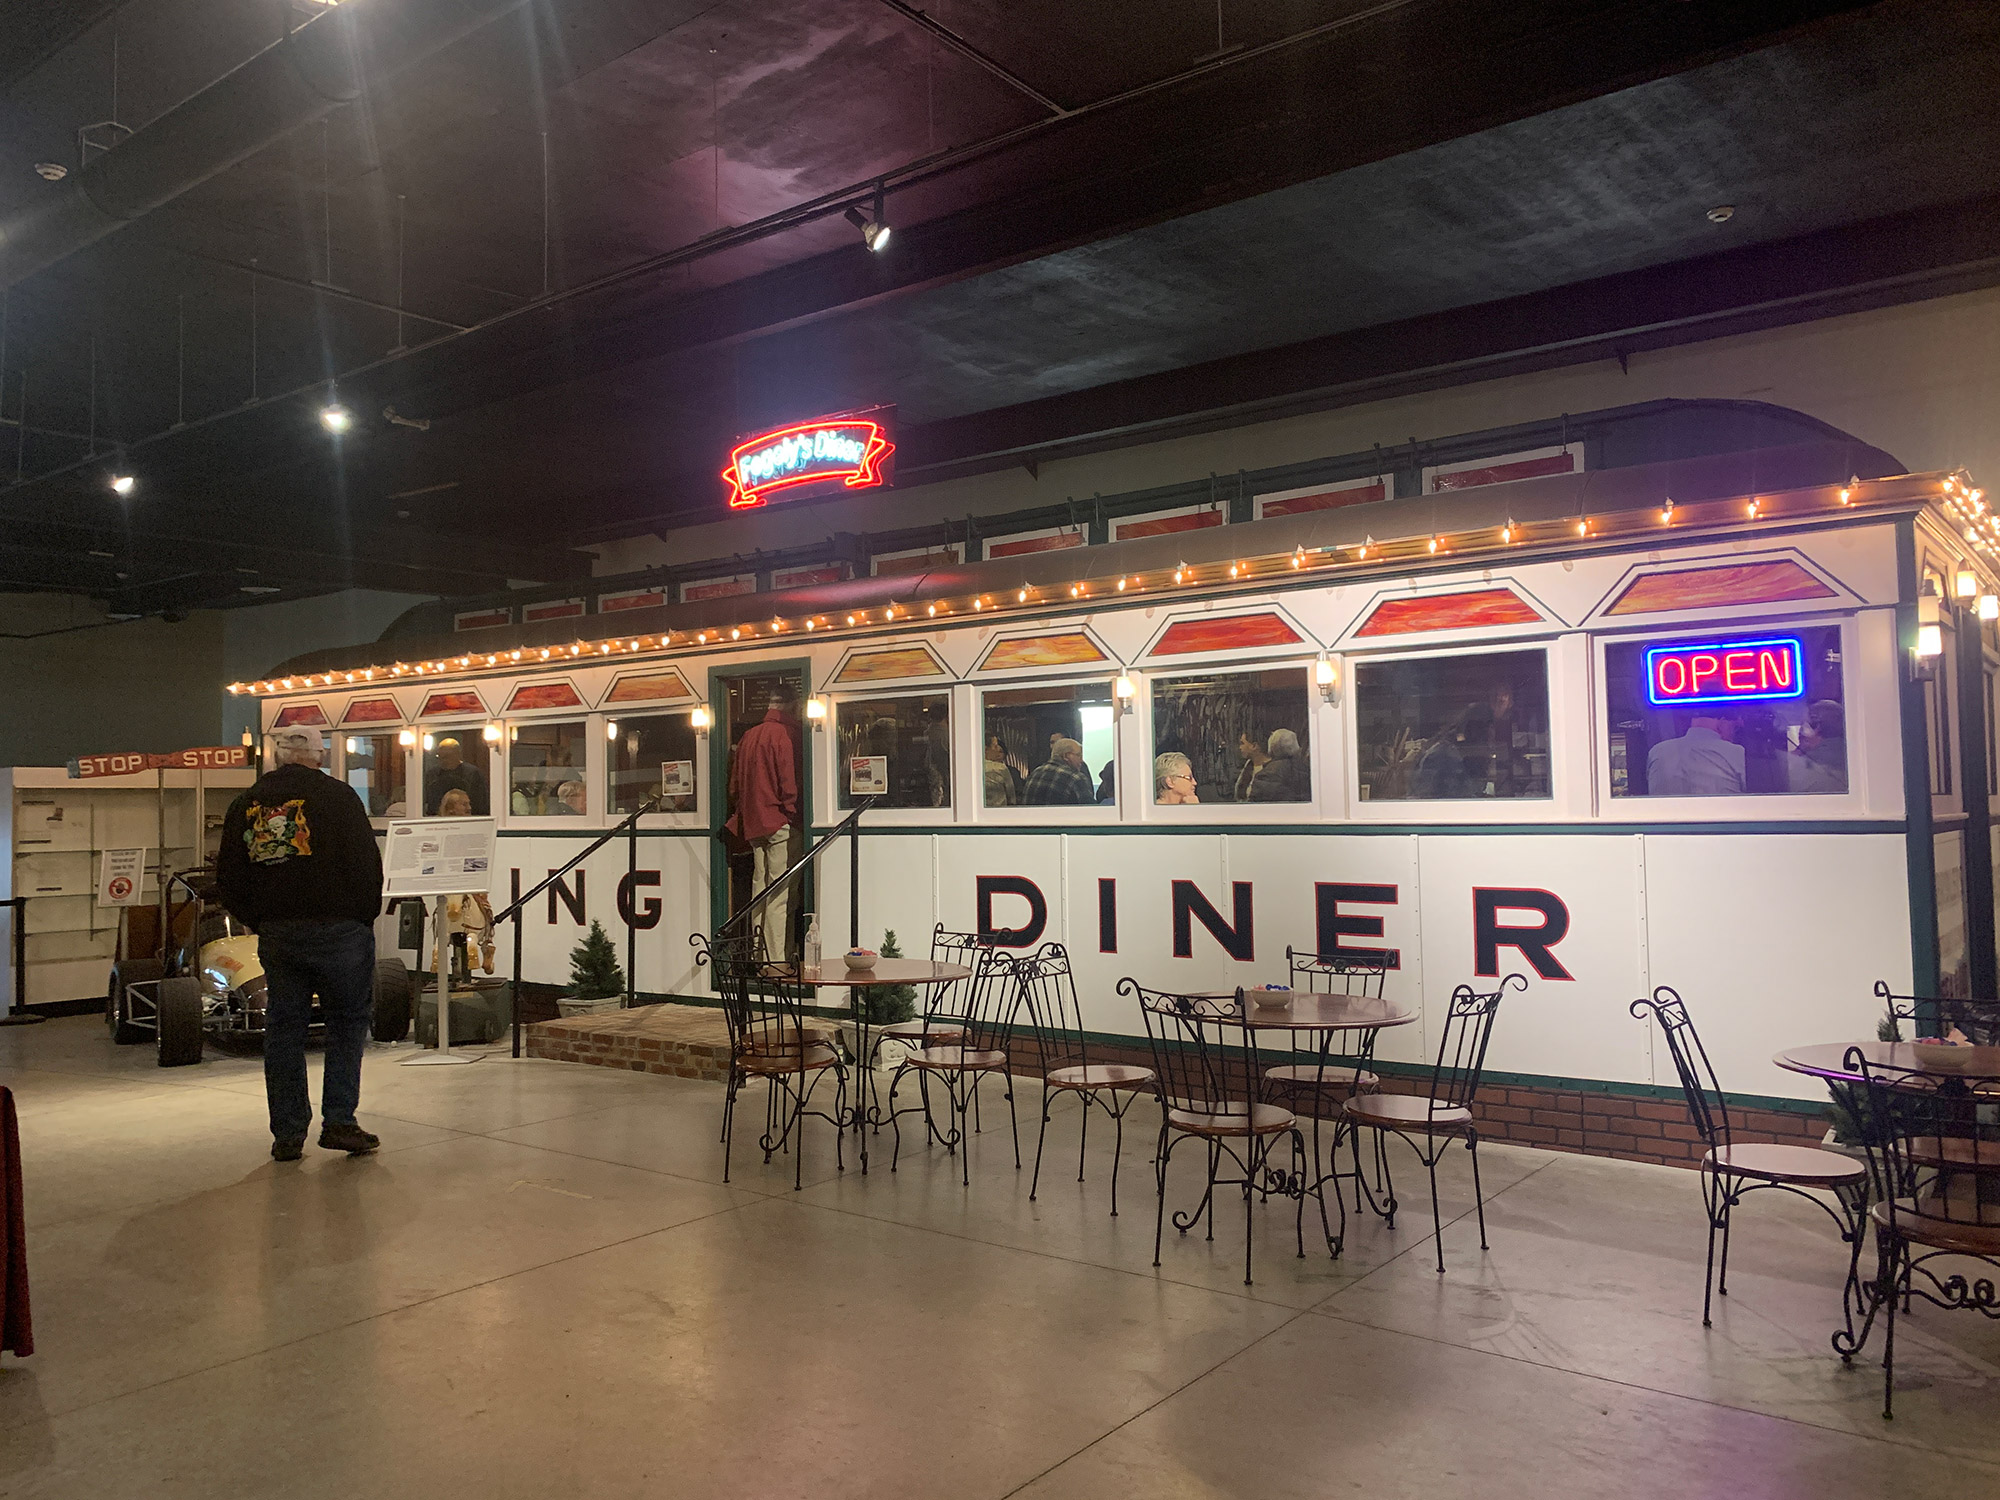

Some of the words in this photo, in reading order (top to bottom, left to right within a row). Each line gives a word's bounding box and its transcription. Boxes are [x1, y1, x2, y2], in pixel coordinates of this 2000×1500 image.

[814, 430, 865, 464] Diner
[1658, 647, 1791, 694] OPEN
[78, 755, 142, 775] STOP
[183, 749, 245, 767] STOP
[510, 867, 662, 930] ING
[976, 875, 1576, 982] DINER
